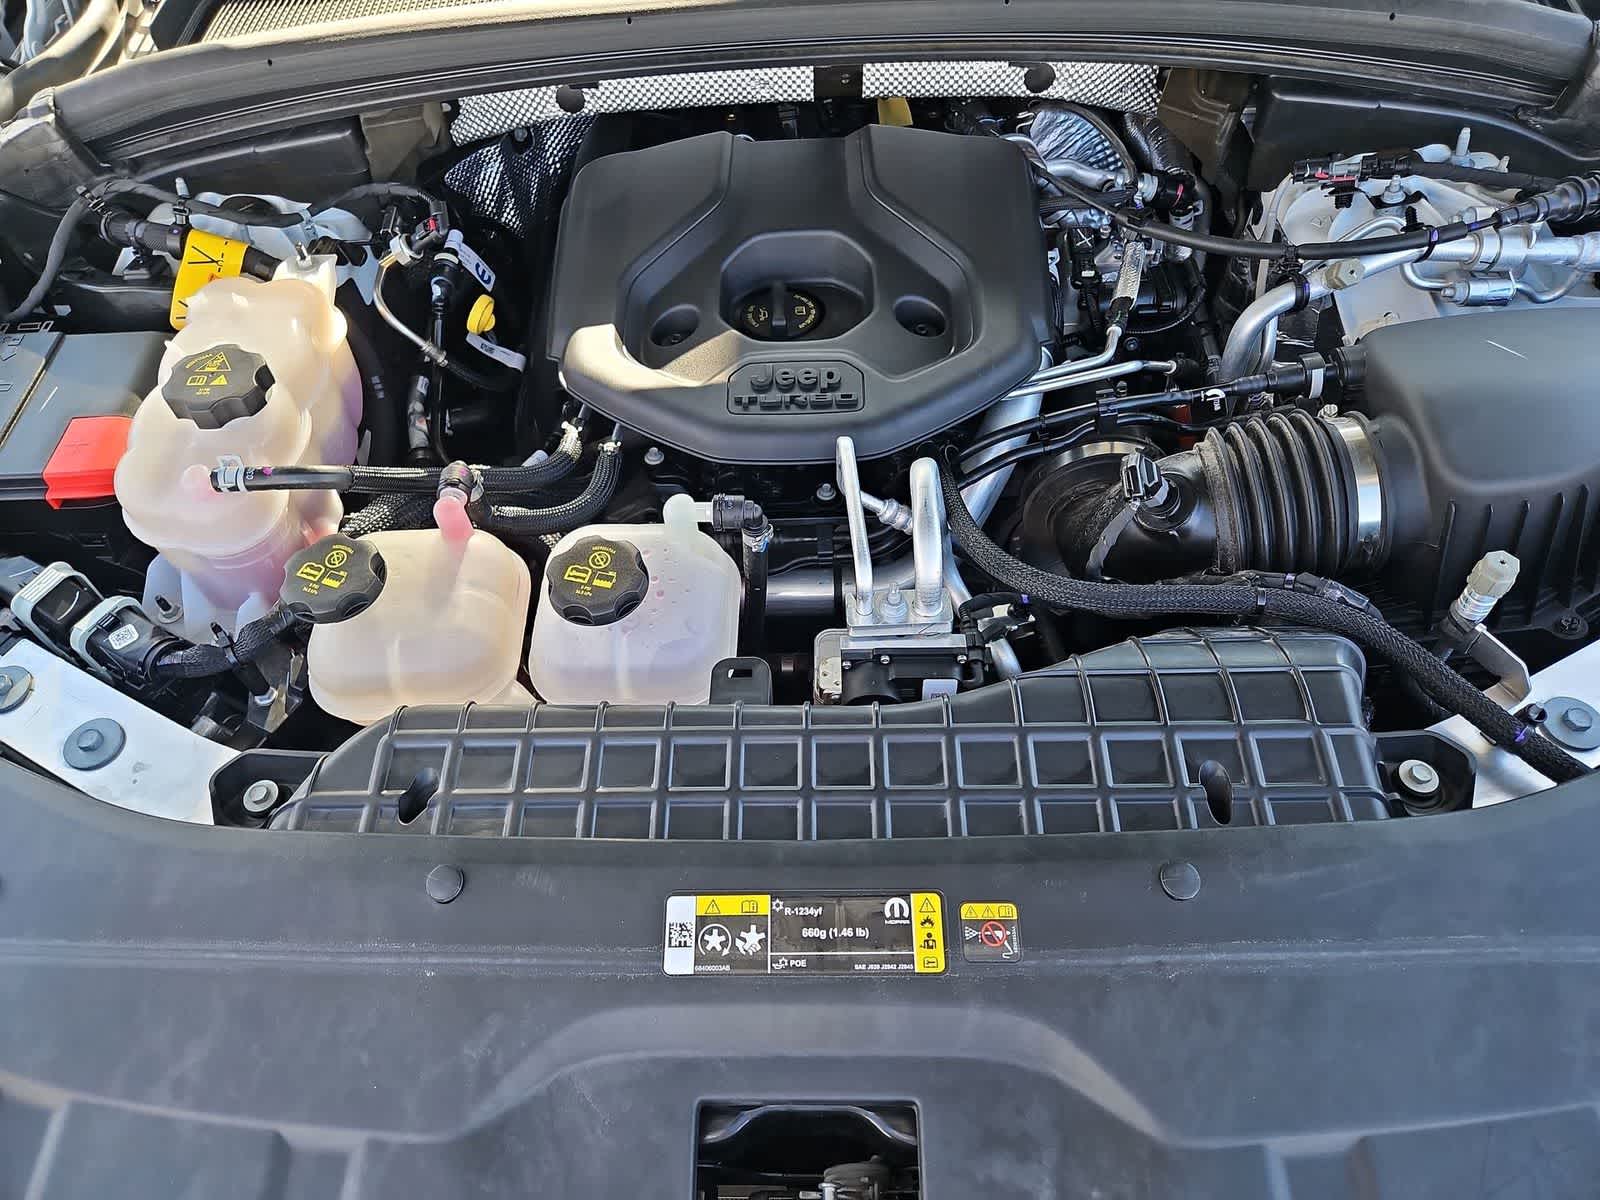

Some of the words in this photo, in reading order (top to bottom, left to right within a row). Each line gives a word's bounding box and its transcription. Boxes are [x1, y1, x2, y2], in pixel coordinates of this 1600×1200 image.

[751, 364, 841, 392] Jeep
[734, 393, 858, 410] TURBO
[784, 906, 823, 917] R-1234yf
[802, 928, 827, 939] 660g
[828, 927, 853, 939] (1.46
[855, 927, 869, 939] lb)
[790, 959, 807, 967] POE
